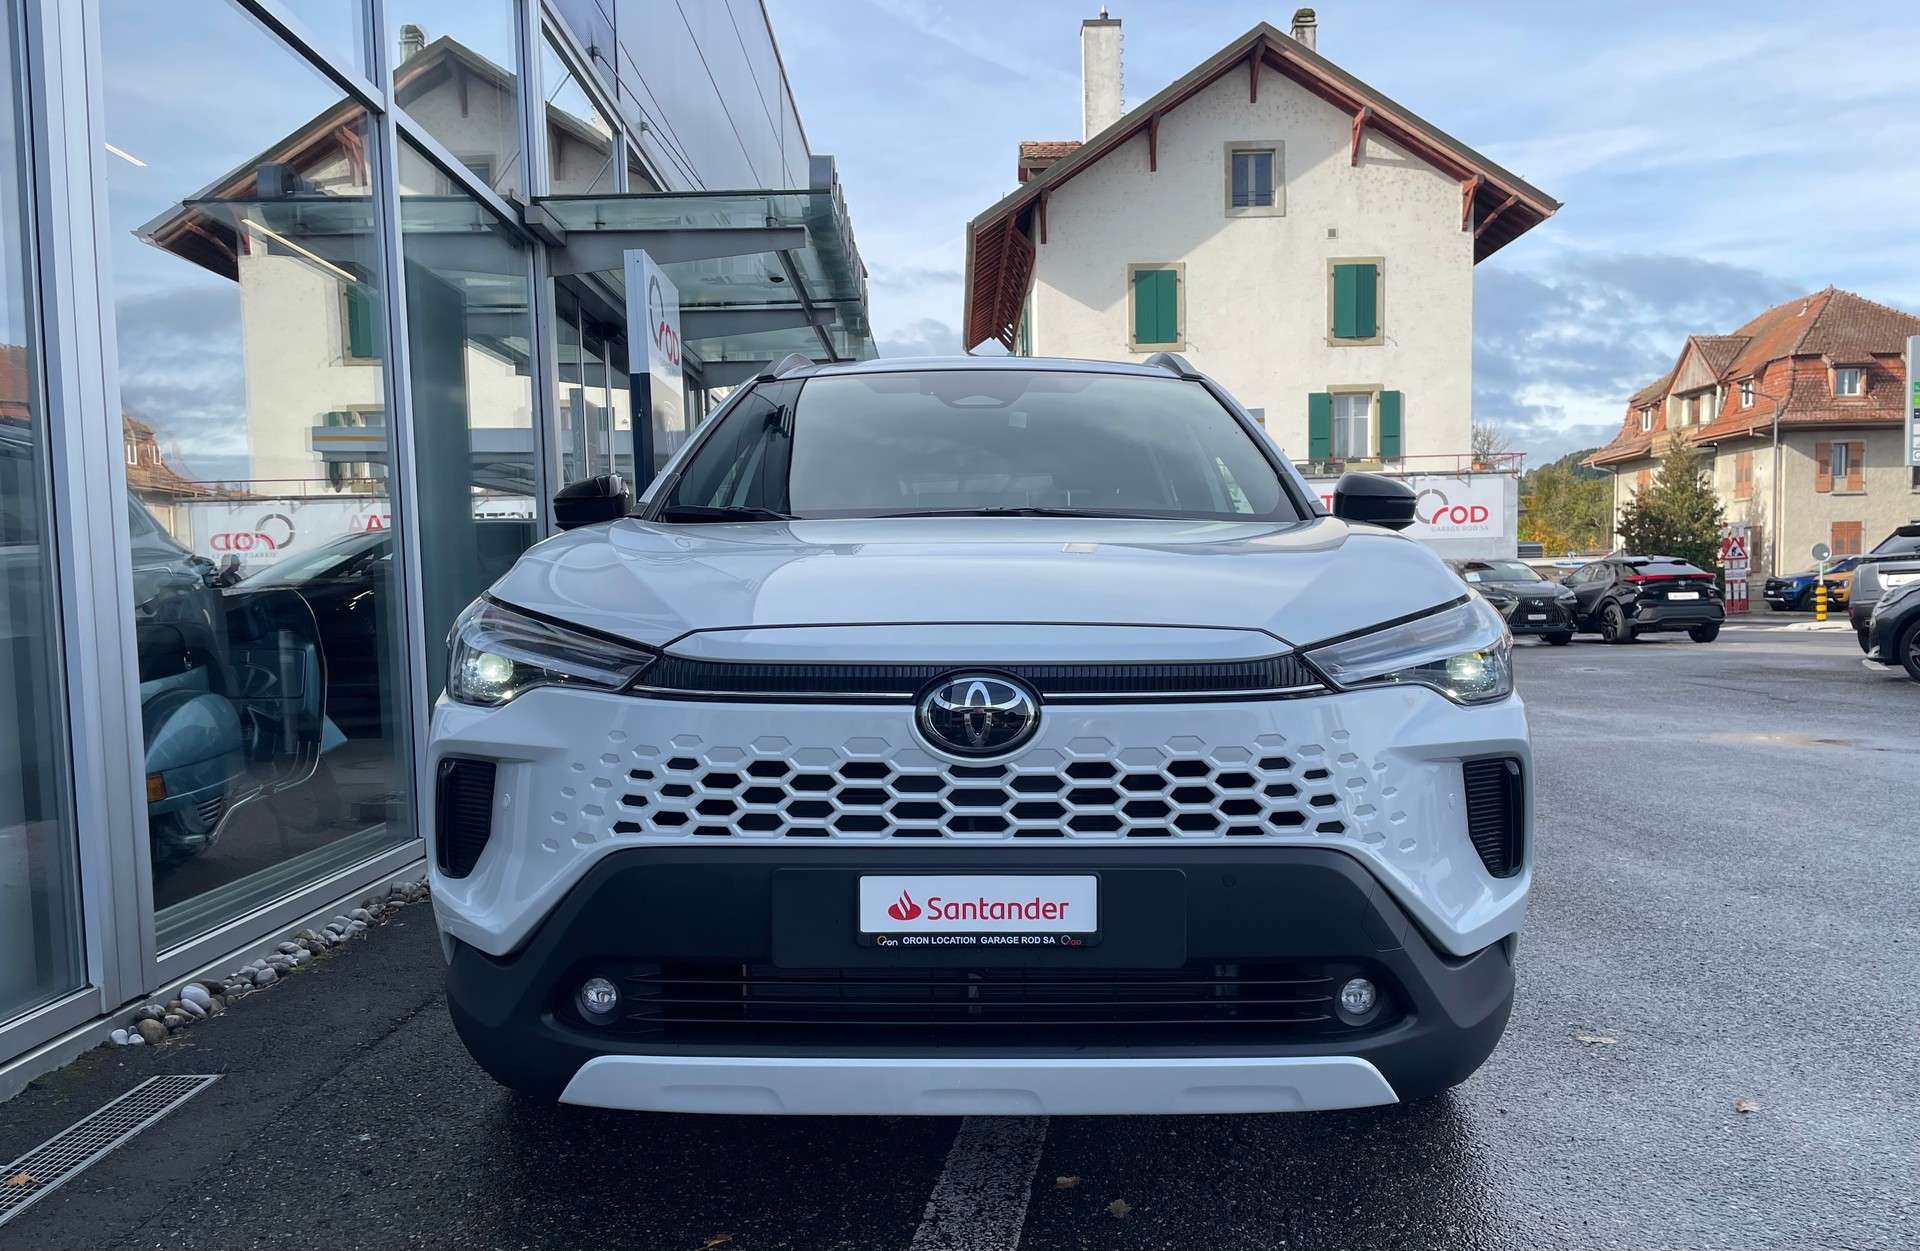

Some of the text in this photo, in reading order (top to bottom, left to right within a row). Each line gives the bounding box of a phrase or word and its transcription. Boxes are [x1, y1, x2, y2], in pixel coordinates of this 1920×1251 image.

[1431, 525, 1461, 533] GARAGE
[927, 897, 1069, 920] Santander
[902, 936, 976, 945] ORON LOCATION
[980, 936, 1056, 944] GARAGE ROD SA
